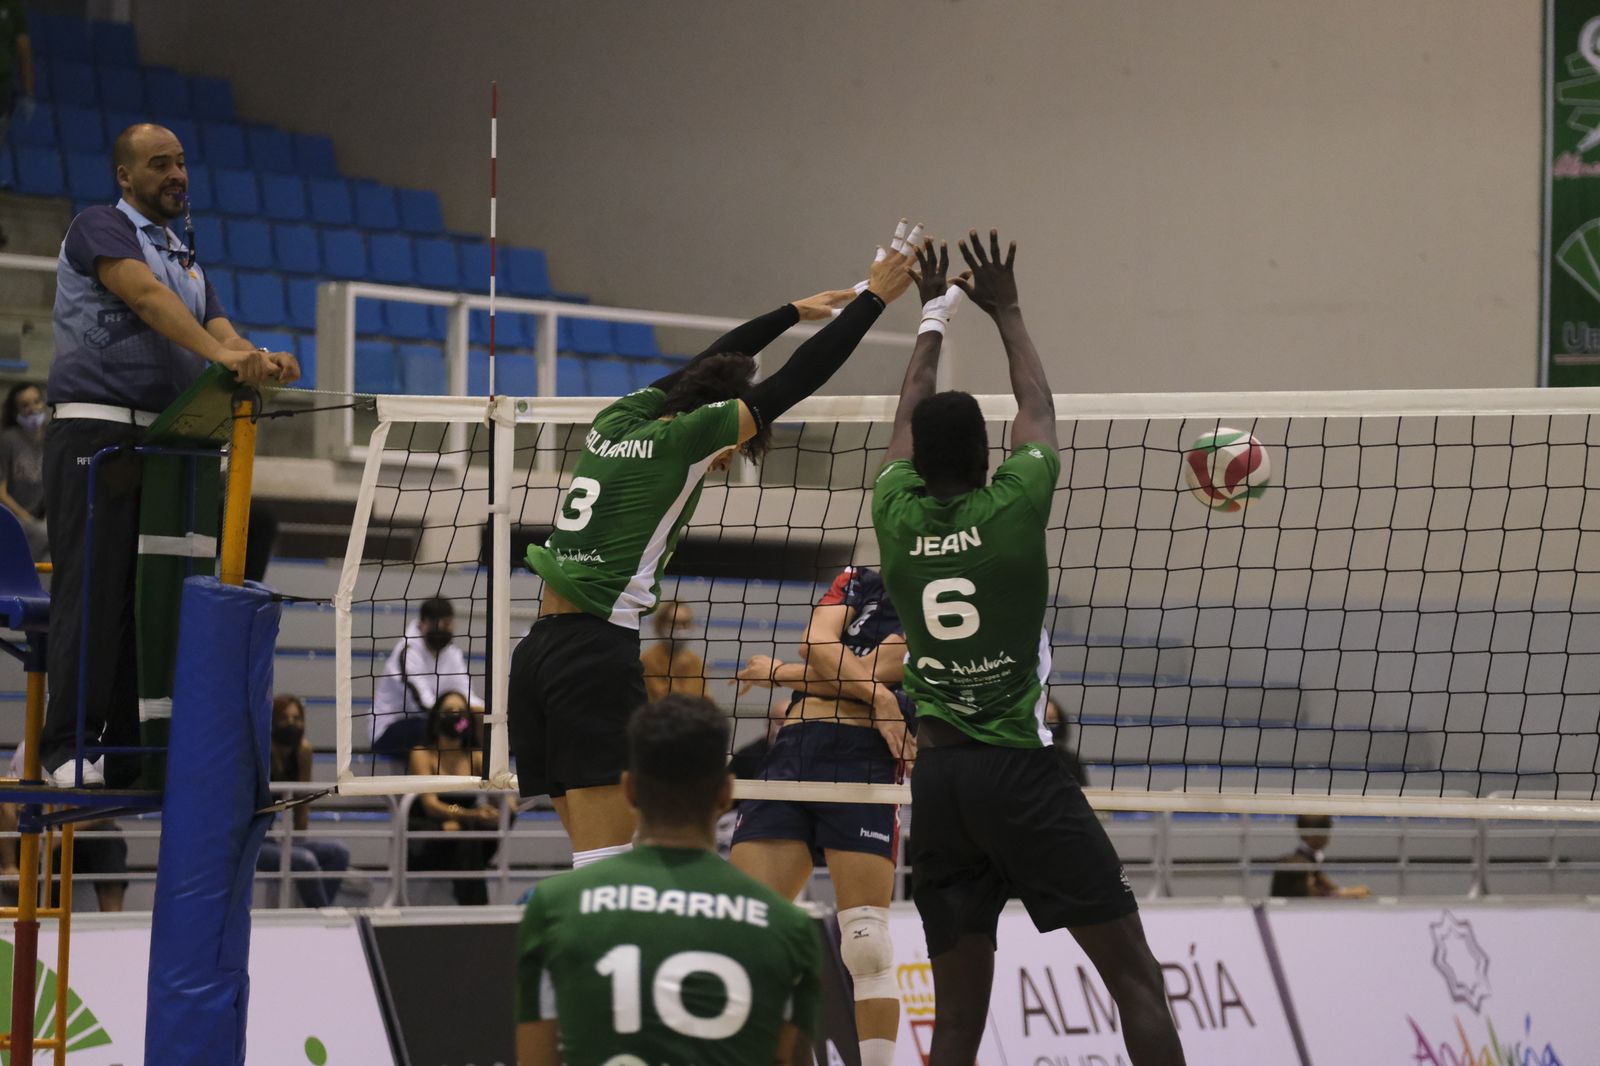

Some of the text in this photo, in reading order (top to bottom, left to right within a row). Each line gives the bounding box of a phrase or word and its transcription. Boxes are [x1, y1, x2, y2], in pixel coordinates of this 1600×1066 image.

[556, 476, 601, 532] 3
[909, 526, 982, 556] JEAN
[922, 577, 981, 641] 6
[580, 885, 769, 928] IRIBARNE
[595, 943, 753, 1040] 10
[1018, 943, 1256, 1037] ALMRÍA
